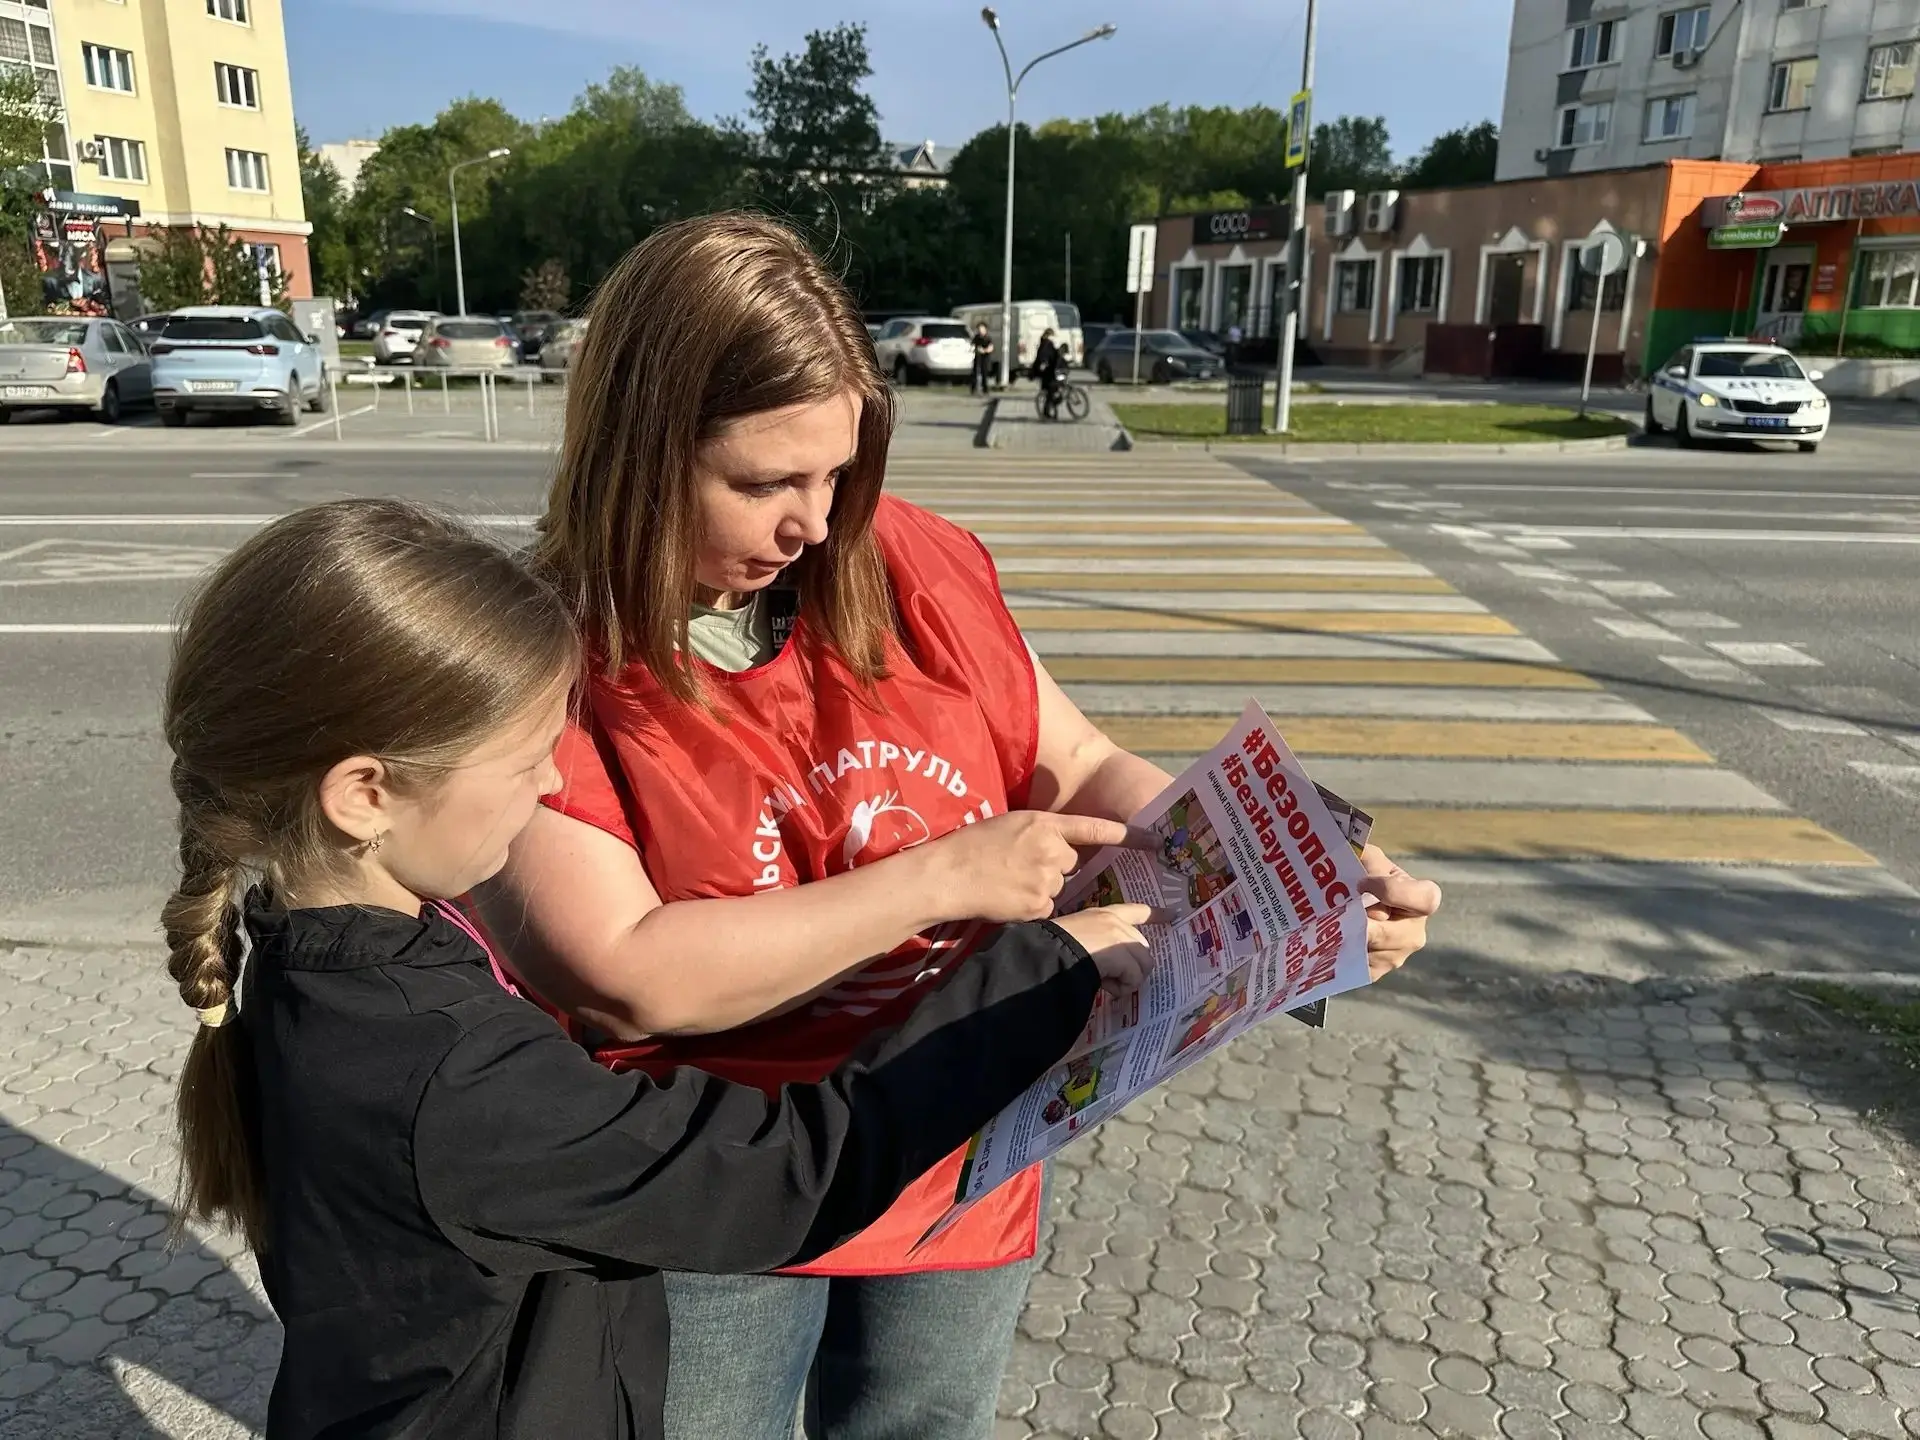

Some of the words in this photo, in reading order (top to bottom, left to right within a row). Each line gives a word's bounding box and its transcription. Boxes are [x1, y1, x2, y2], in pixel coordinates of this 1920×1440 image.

[1786, 183, 1920, 219] АПТЕКА
[806, 740, 968, 798] ПАТРУЛЬ
[1207, 770, 1228, 803] НАЧИНАЯ
[1222, 801, 1246, 838] ПЕРЕХОД
[1240, 835, 1258, 863] УЛИЦЫ
[1258, 873, 1290, 932] ПЕШЕХОДНОМУ
[1242, 727, 1351, 909] #Безопас
[1228, 837, 1258, 889] ПРОПУСКАЮТ
[1252, 886, 1268, 907] ВАС!
